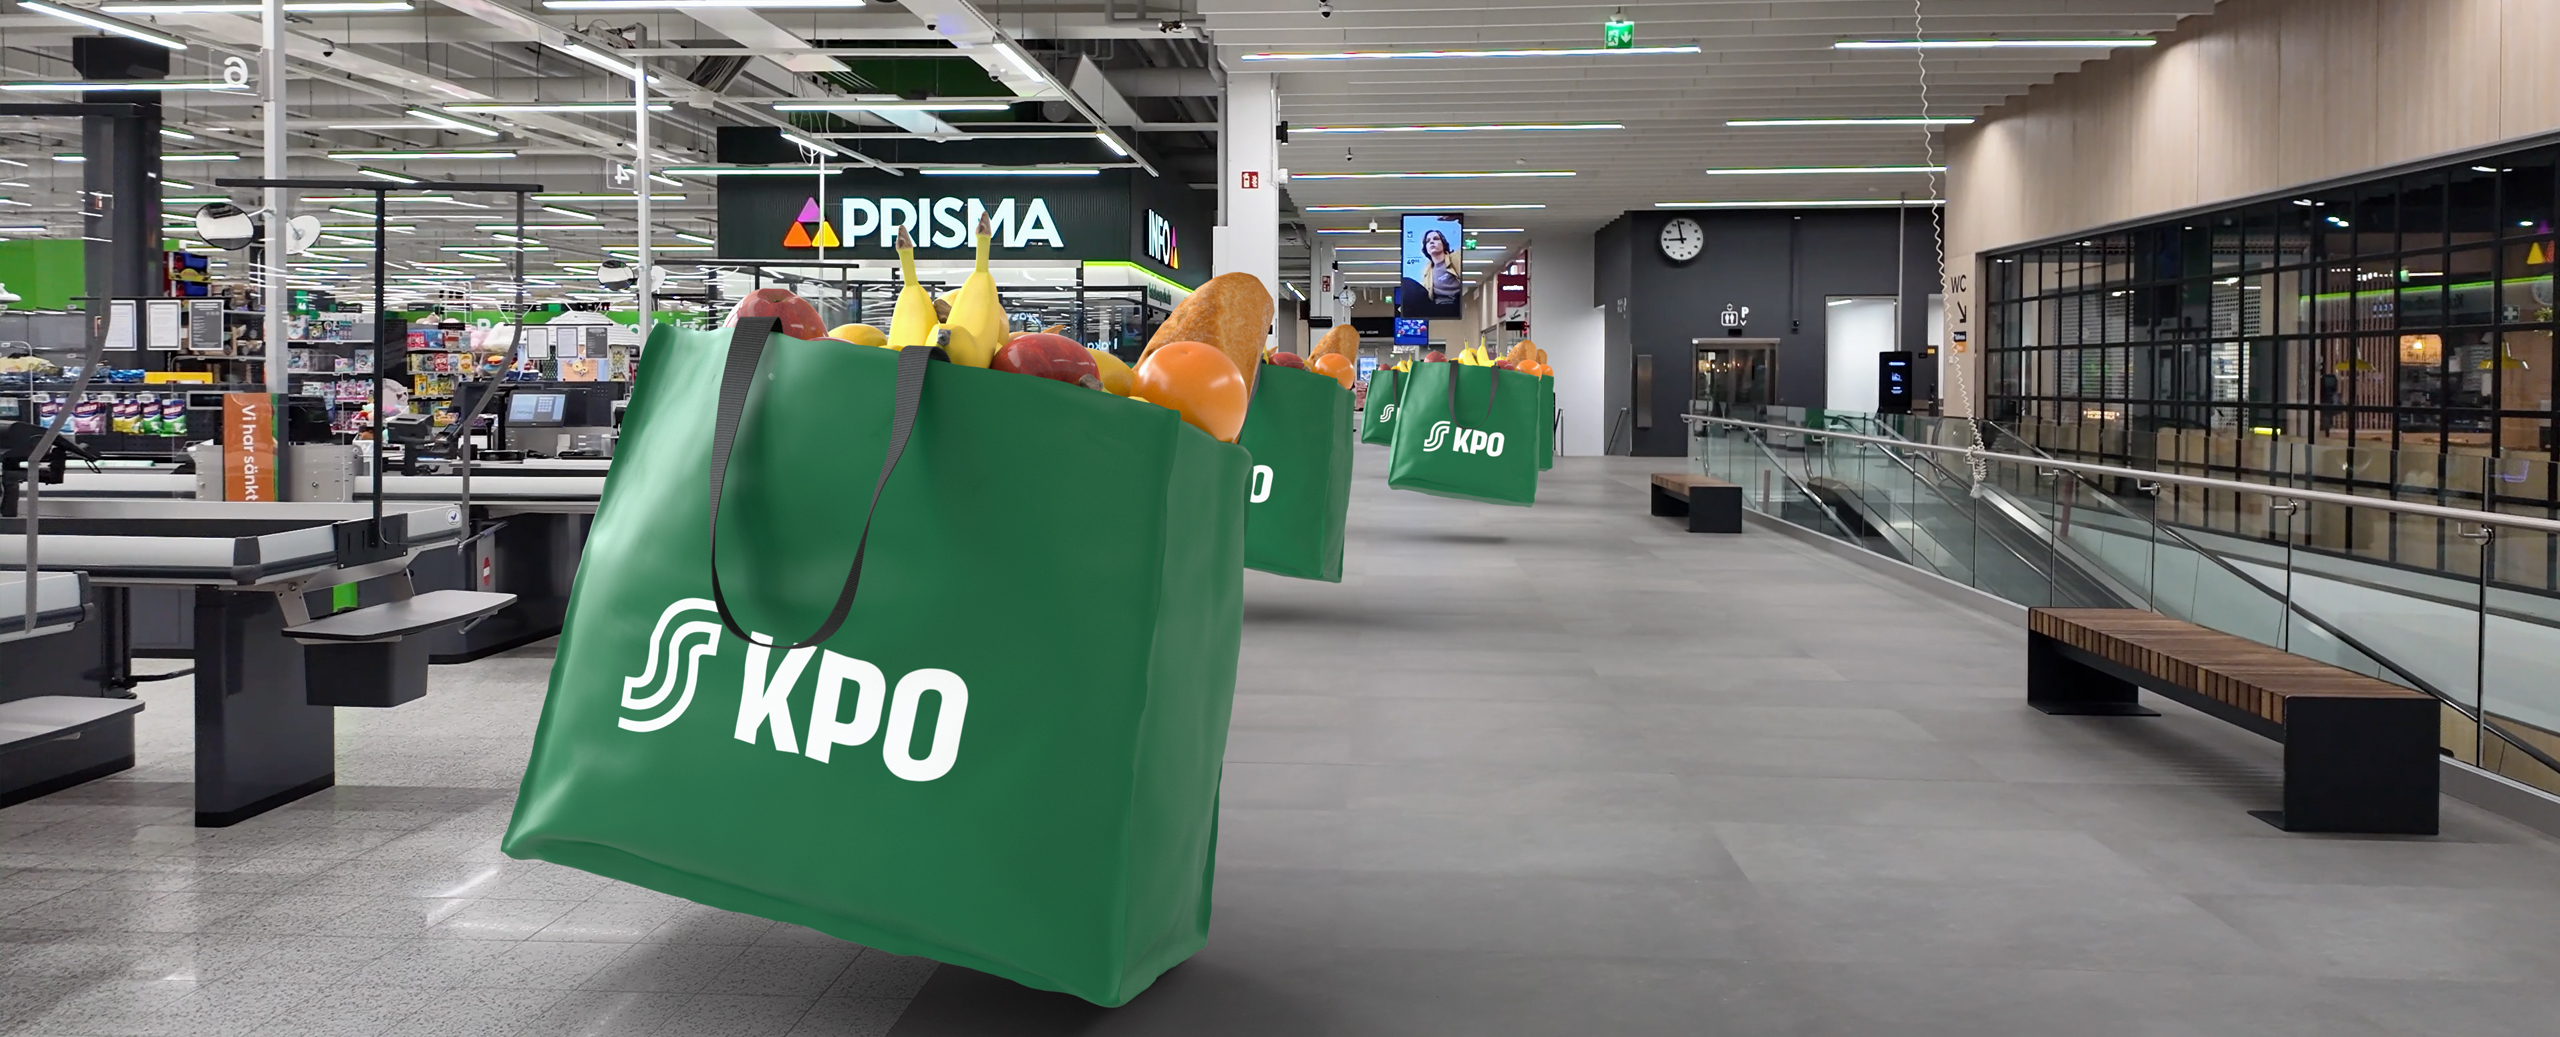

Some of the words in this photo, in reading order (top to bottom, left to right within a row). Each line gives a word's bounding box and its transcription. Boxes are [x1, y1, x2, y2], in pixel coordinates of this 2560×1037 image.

[842, 197, 1064, 249] PRISMA
[1148, 208, 1171, 265] INFO
[1951, 274, 1967, 294] WC
[1741, 306, 1750, 319] P
[242, 404, 257, 421] Vi
[242, 424, 257, 452] har
[1452, 426, 1505, 457] KPO
[243, 456, 259, 501] sänkt
[734, 630, 969, 782] KPO
